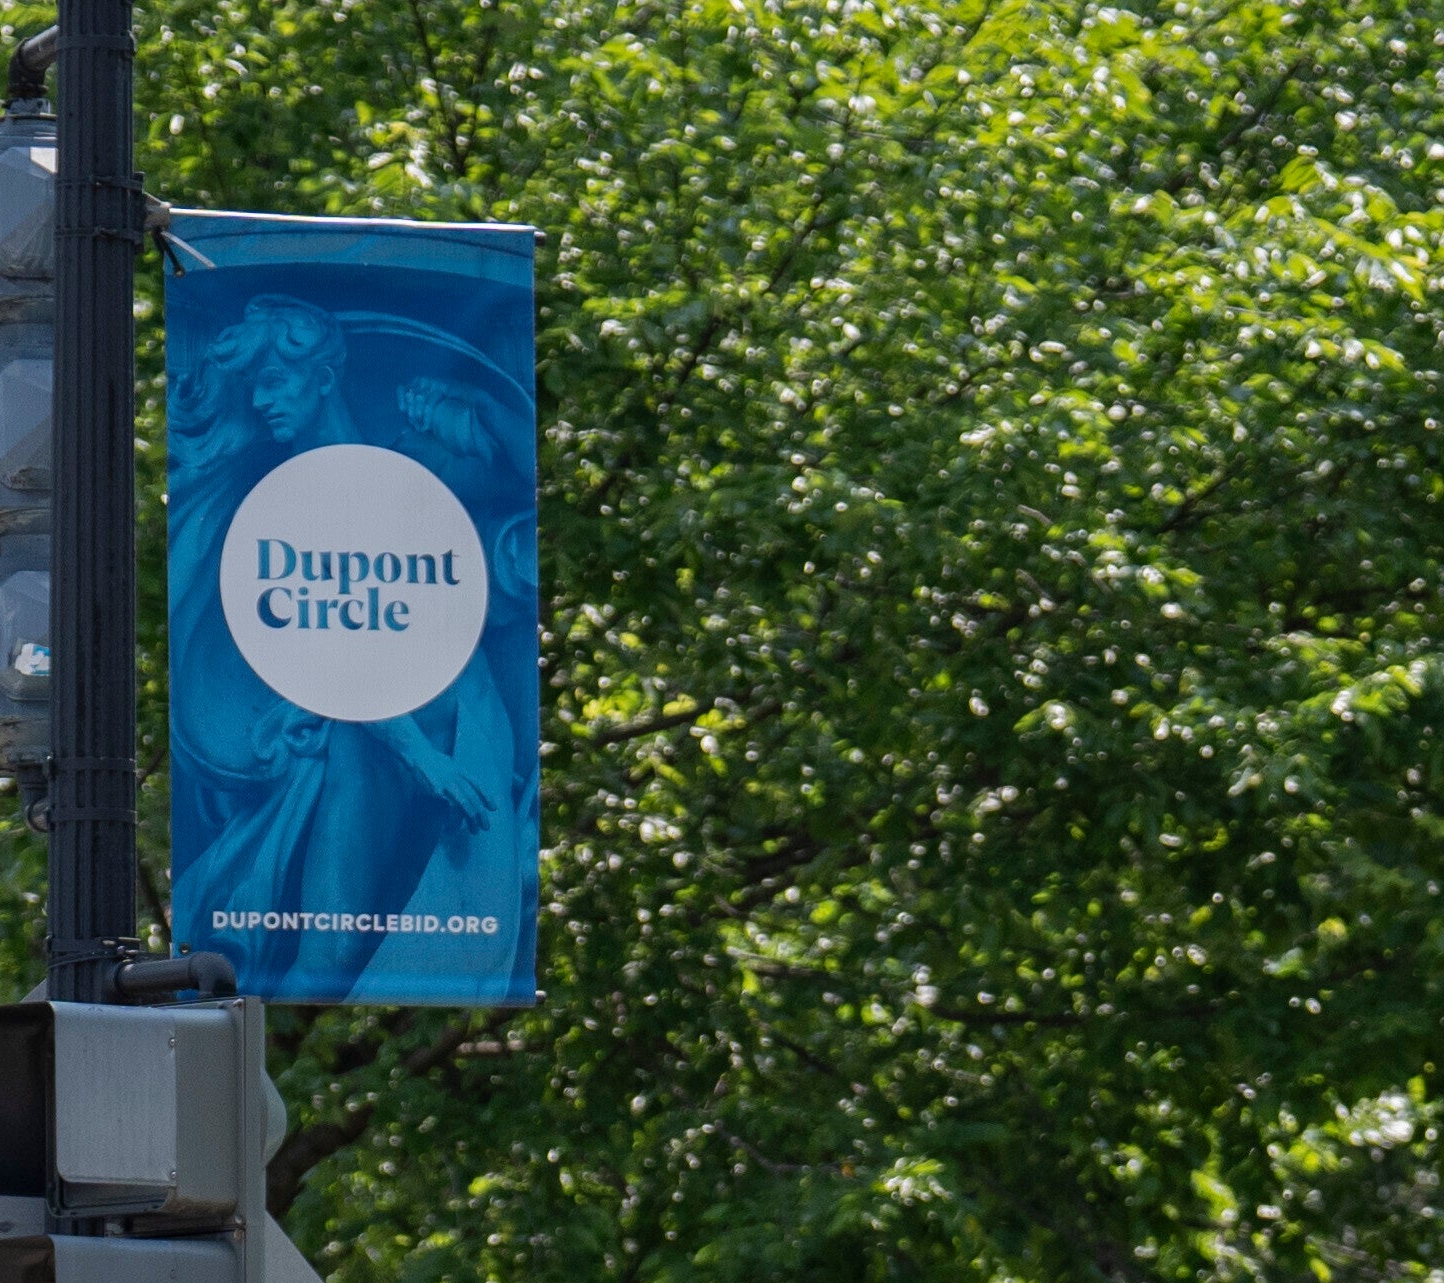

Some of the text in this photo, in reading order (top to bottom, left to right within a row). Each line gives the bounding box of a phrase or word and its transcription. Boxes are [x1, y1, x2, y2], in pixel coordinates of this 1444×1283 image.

[256, 537, 461, 597] Dupont
[255, 585, 411, 633] Circle
[212, 911, 499, 934] DUPONTCIRCLEBID.ORG
